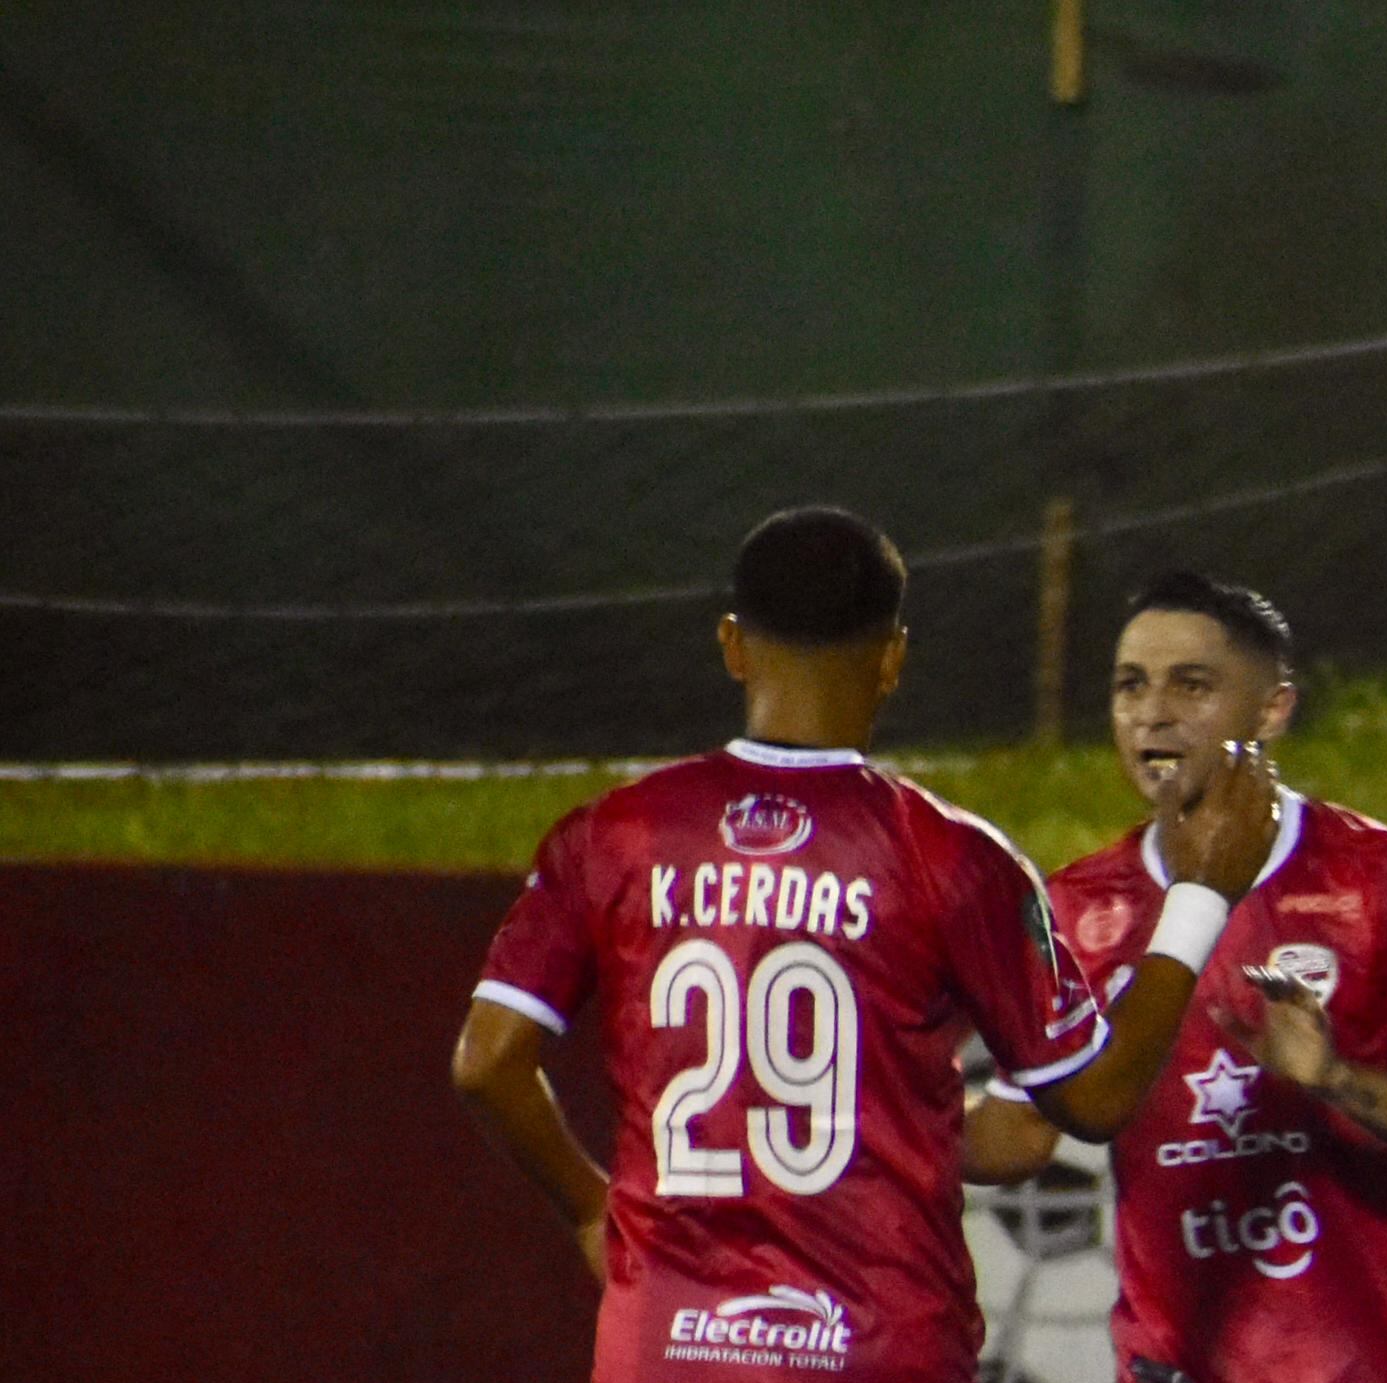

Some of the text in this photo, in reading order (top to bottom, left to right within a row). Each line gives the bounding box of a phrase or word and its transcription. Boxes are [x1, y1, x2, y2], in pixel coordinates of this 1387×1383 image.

[651, 864, 873, 940] K.CERDAS
[649, 938, 858, 1196] 29
[670, 1308, 850, 1354] Electrolit
